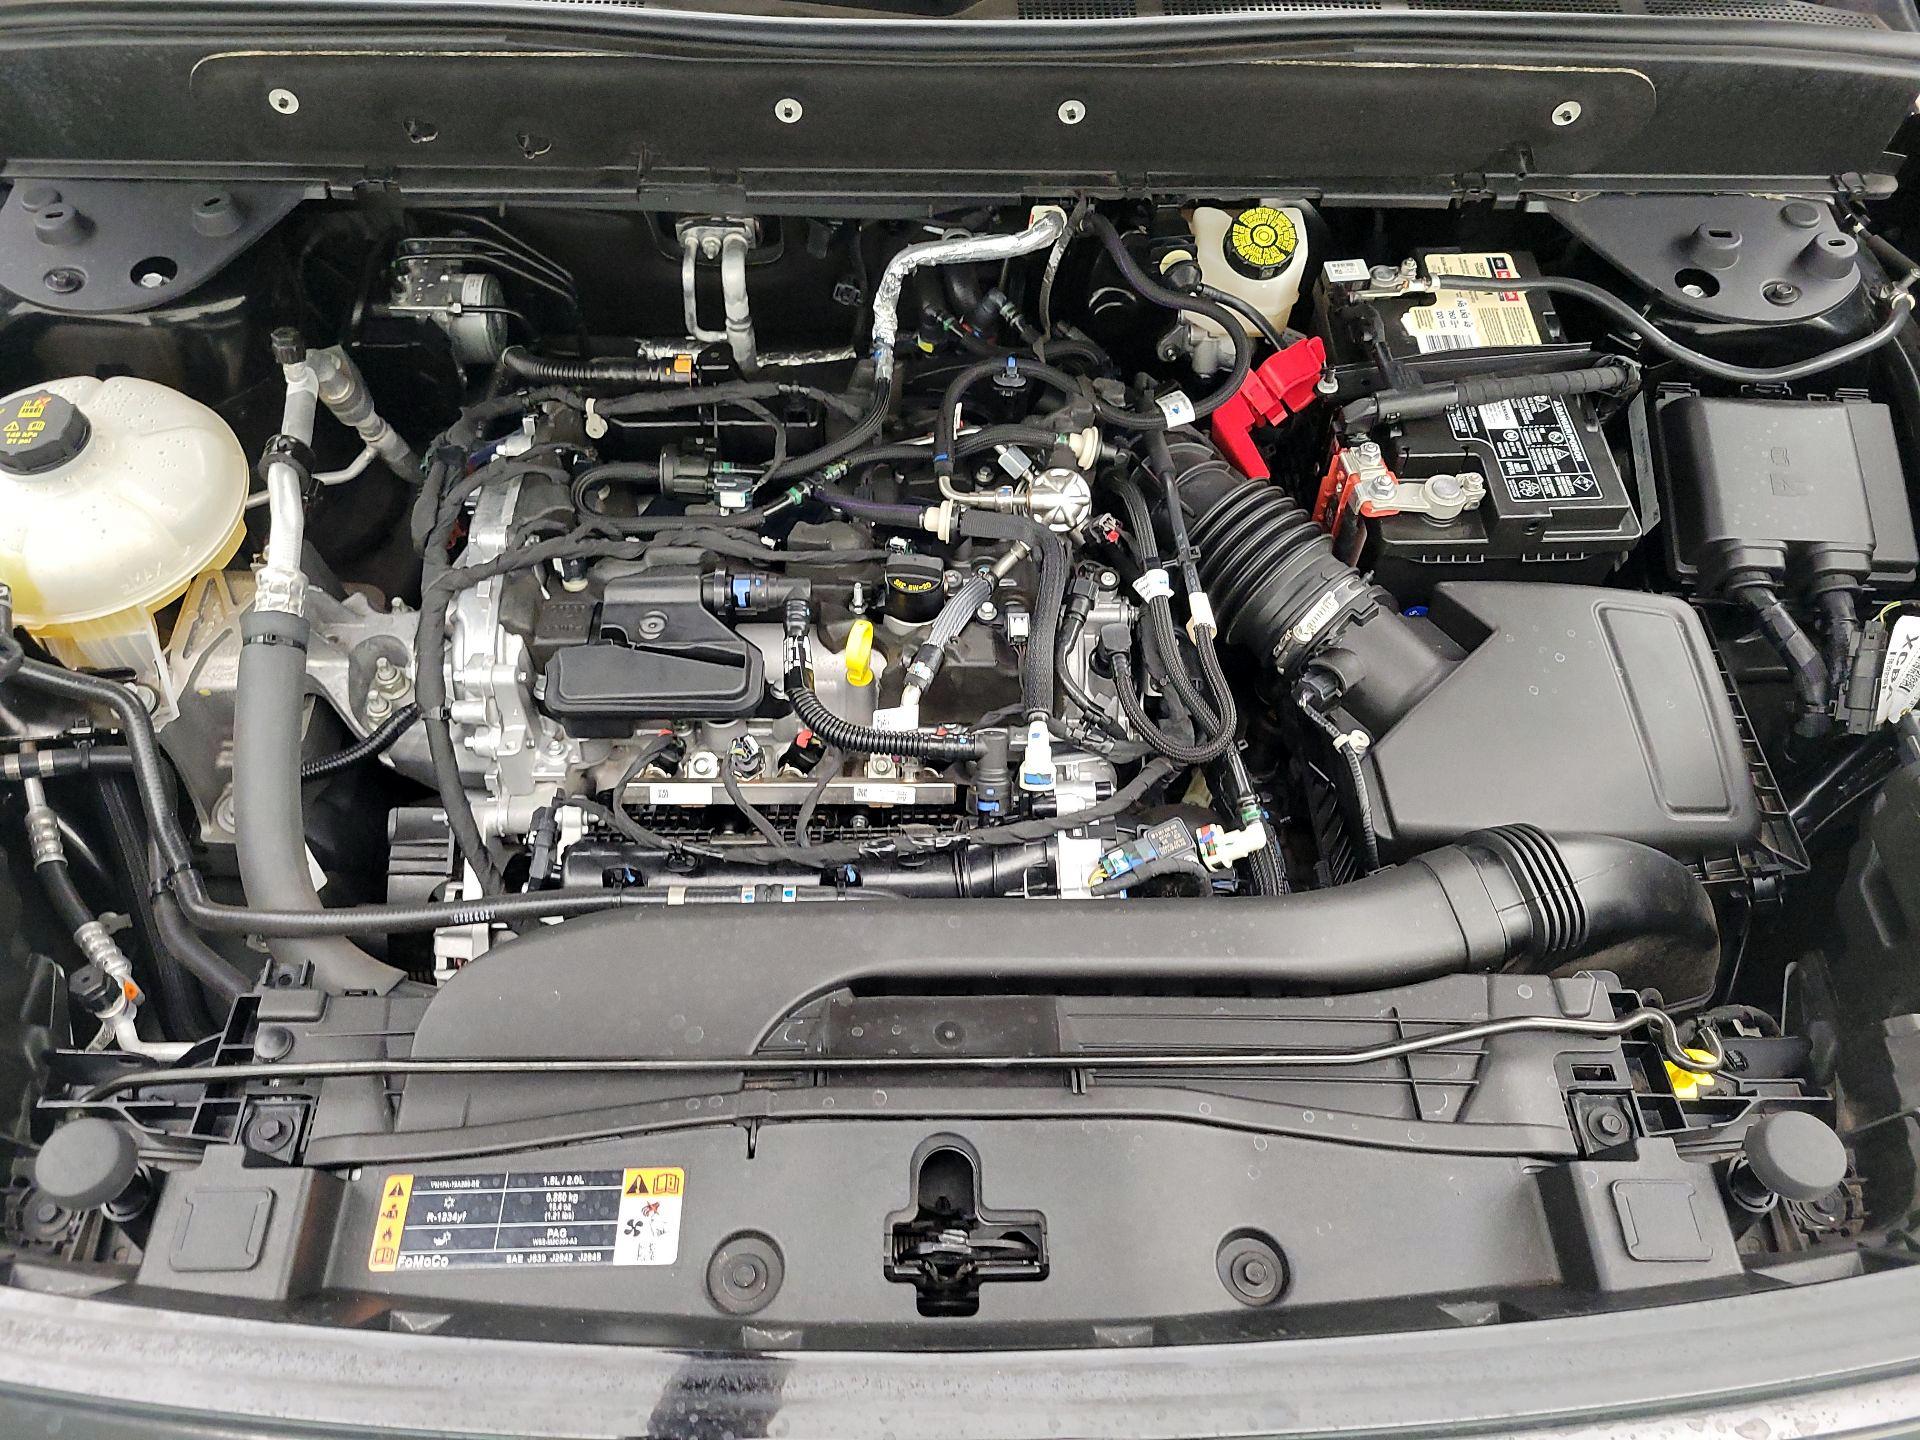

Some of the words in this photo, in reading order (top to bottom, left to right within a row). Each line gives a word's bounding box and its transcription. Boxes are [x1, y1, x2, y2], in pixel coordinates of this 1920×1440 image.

[893, 578, 906, 590] SAE
[908, 582, 932, 591] 5W-20
[397, 1254, 449, 1268] FoMoCo
